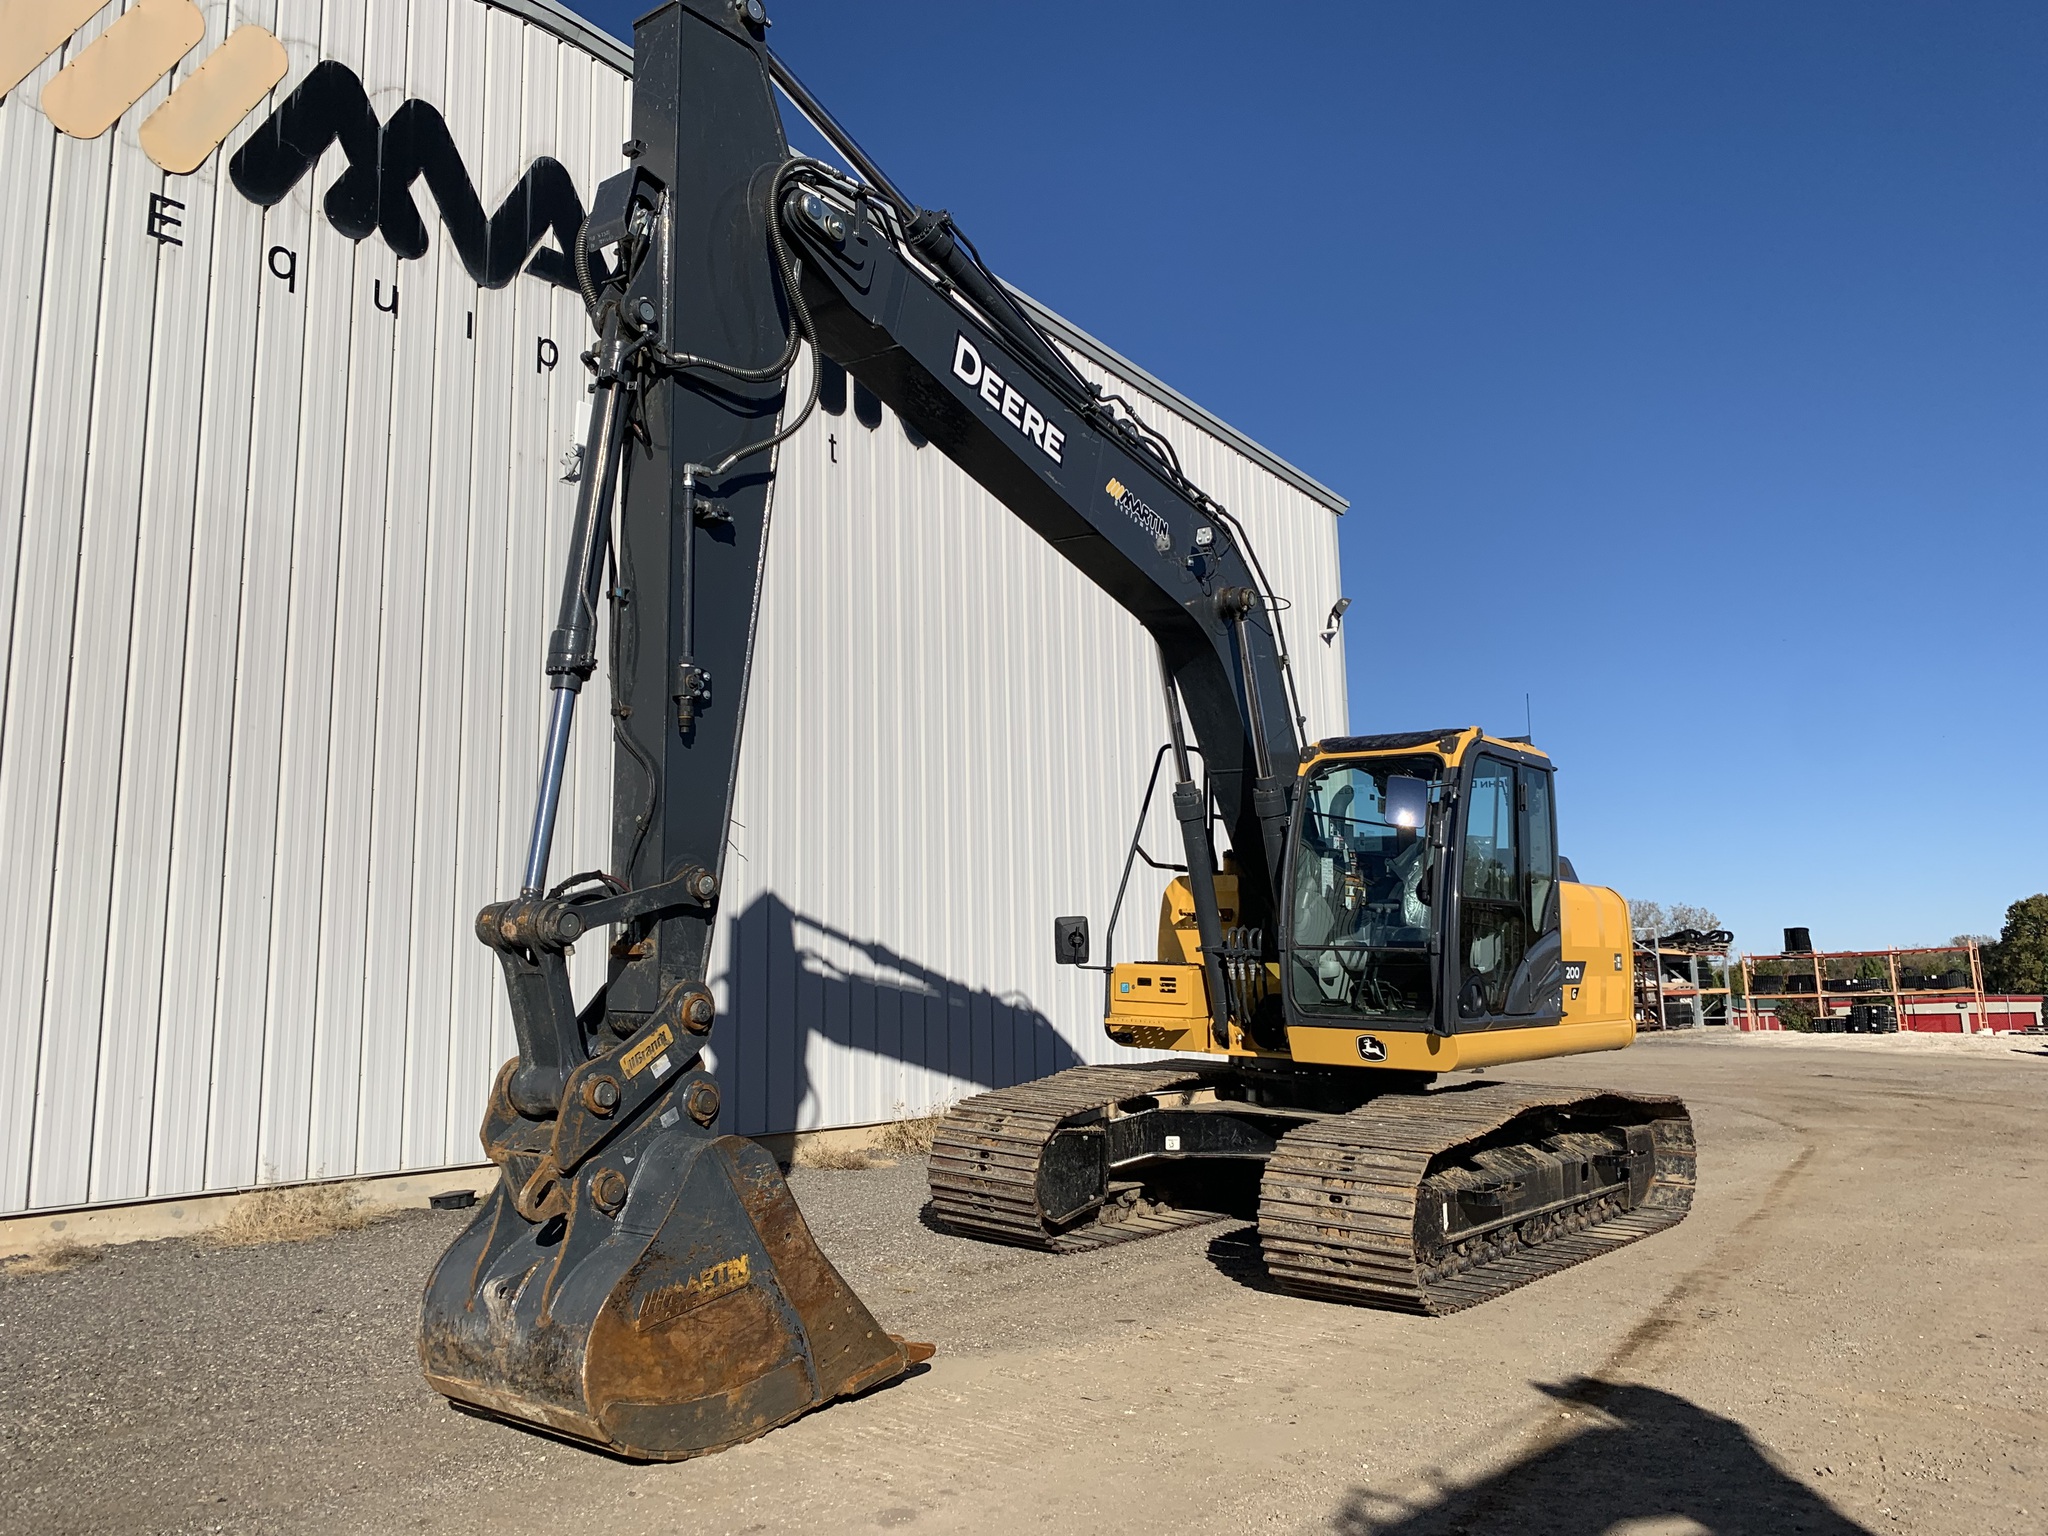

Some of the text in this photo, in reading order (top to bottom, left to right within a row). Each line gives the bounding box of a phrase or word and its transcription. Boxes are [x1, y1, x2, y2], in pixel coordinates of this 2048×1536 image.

[953, 334, 1066, 465] DEERE
[1119, 488, 1169, 540] MARTIN
[1565, 966, 1580, 980] 200
